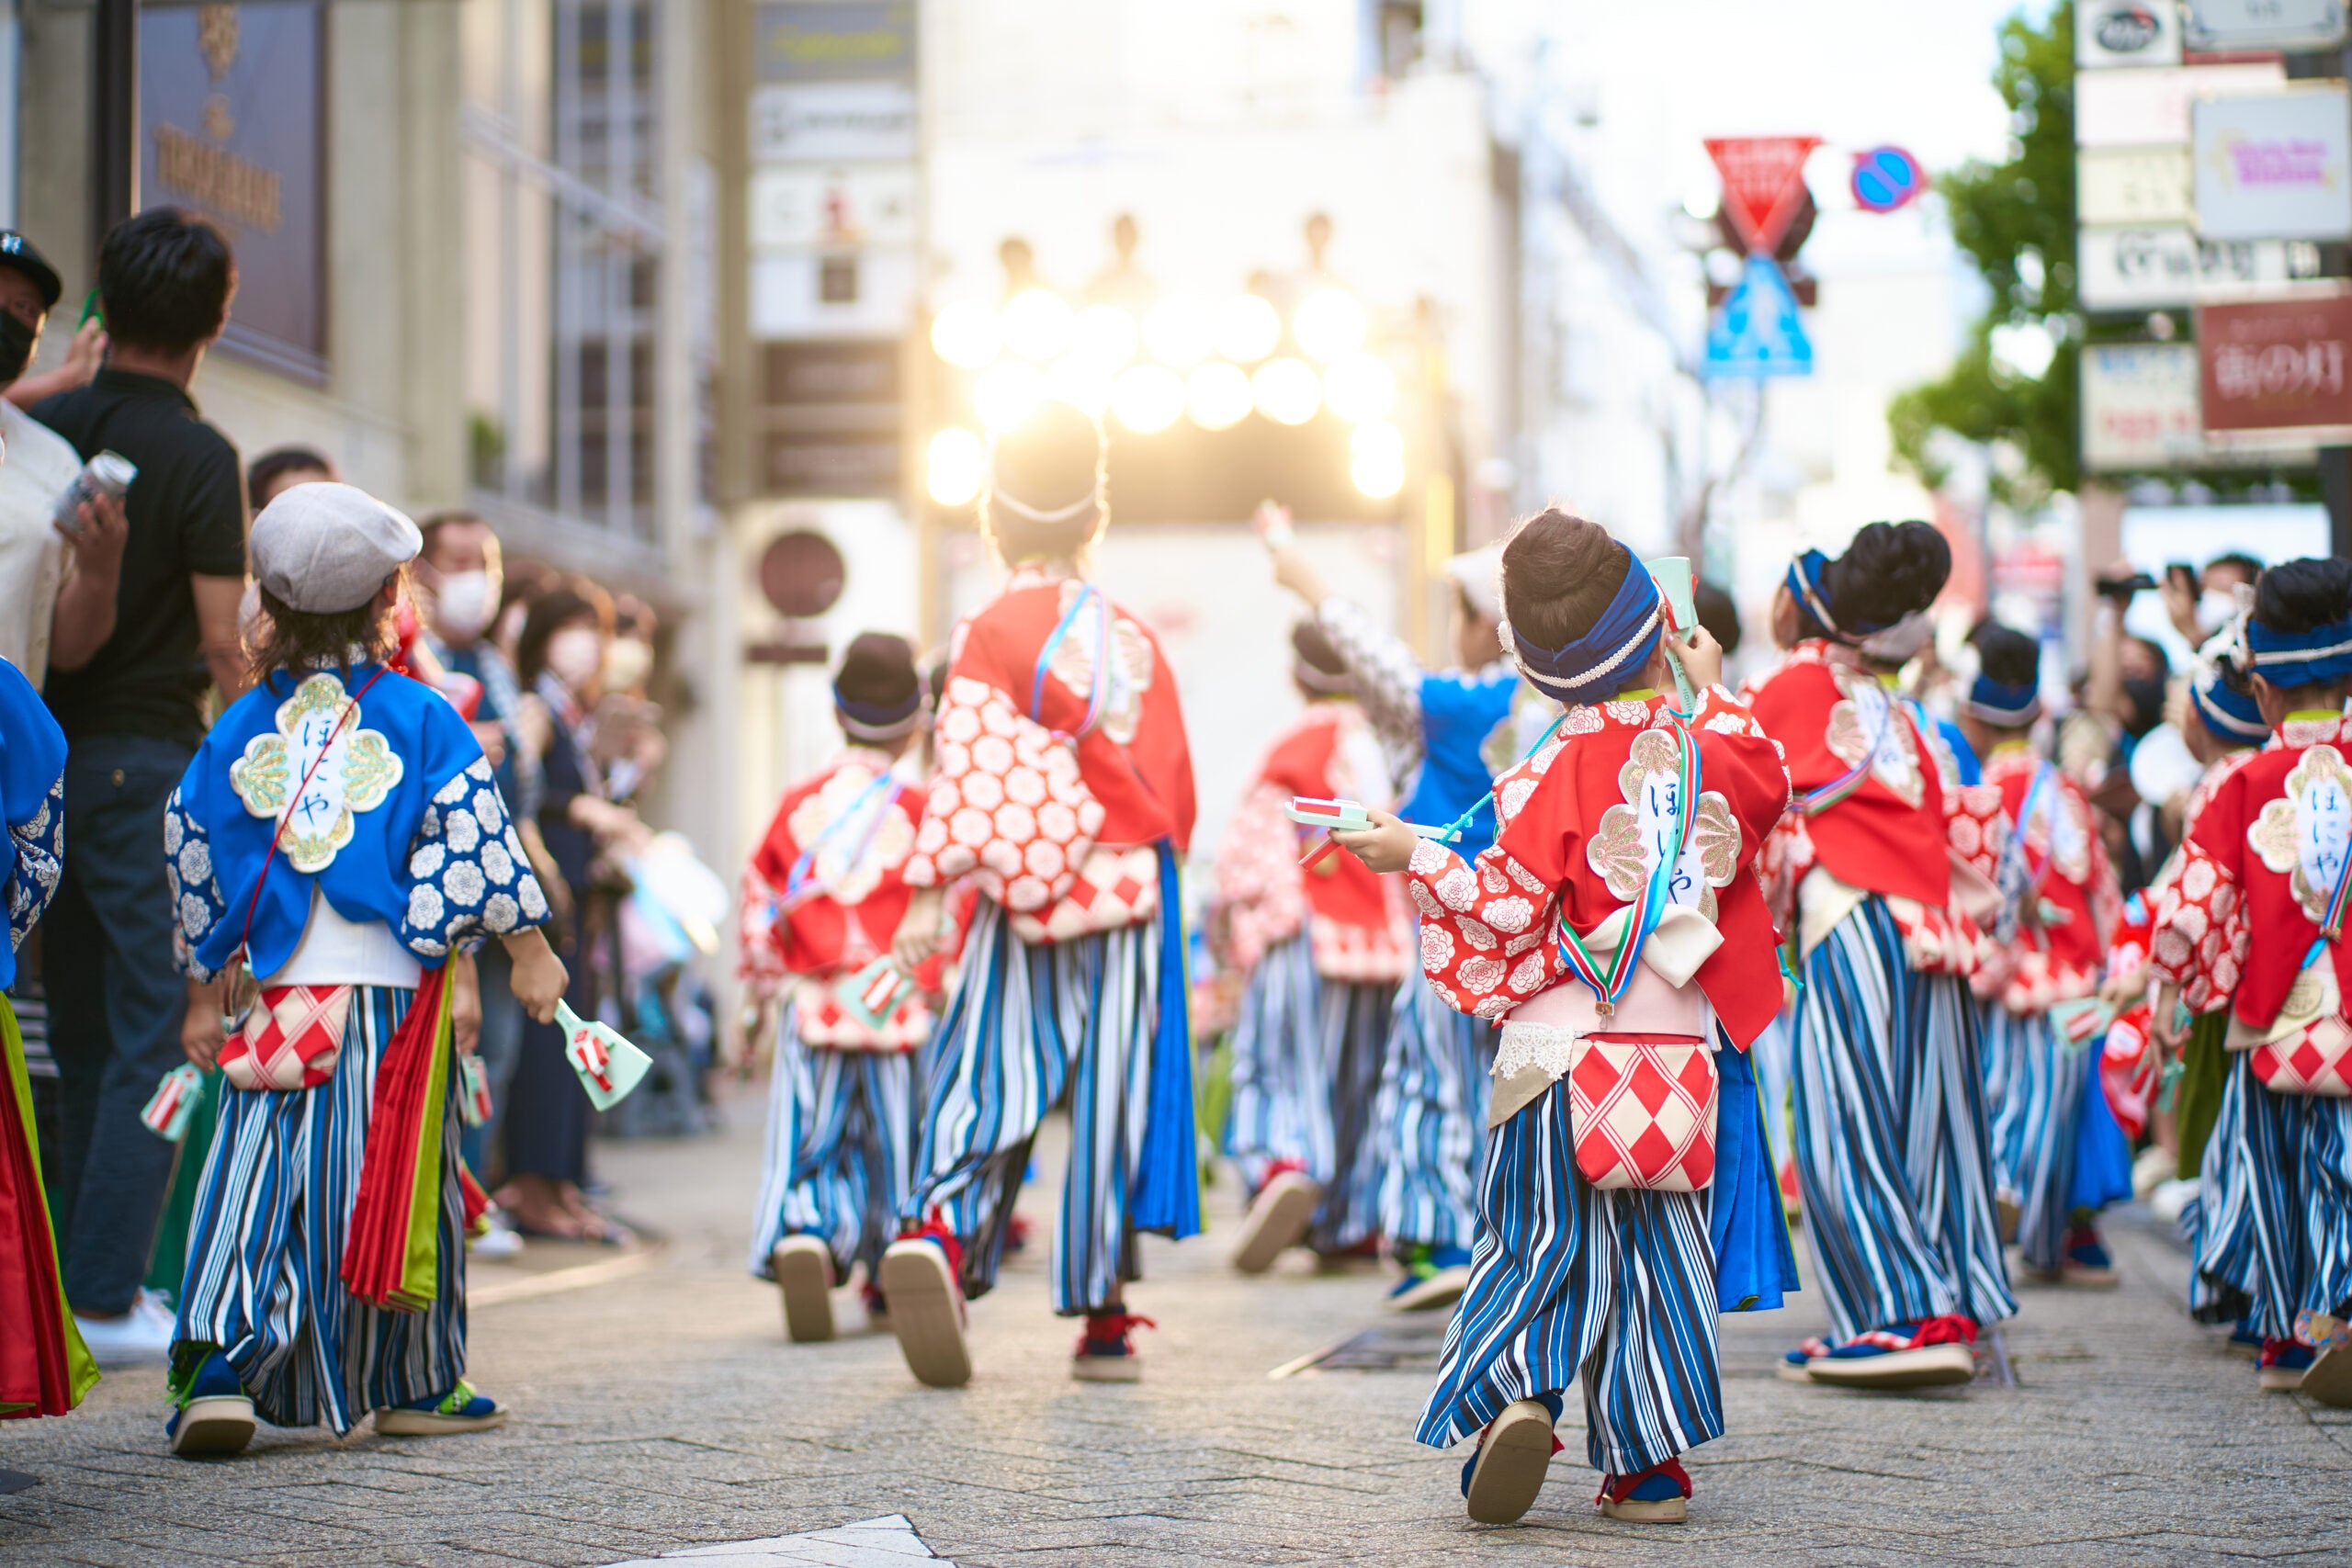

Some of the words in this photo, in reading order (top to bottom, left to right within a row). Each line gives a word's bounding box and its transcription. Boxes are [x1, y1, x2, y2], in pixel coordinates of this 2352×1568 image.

[298, 720, 332, 826] ほにや
[2311, 787, 2340, 881] ほにや
